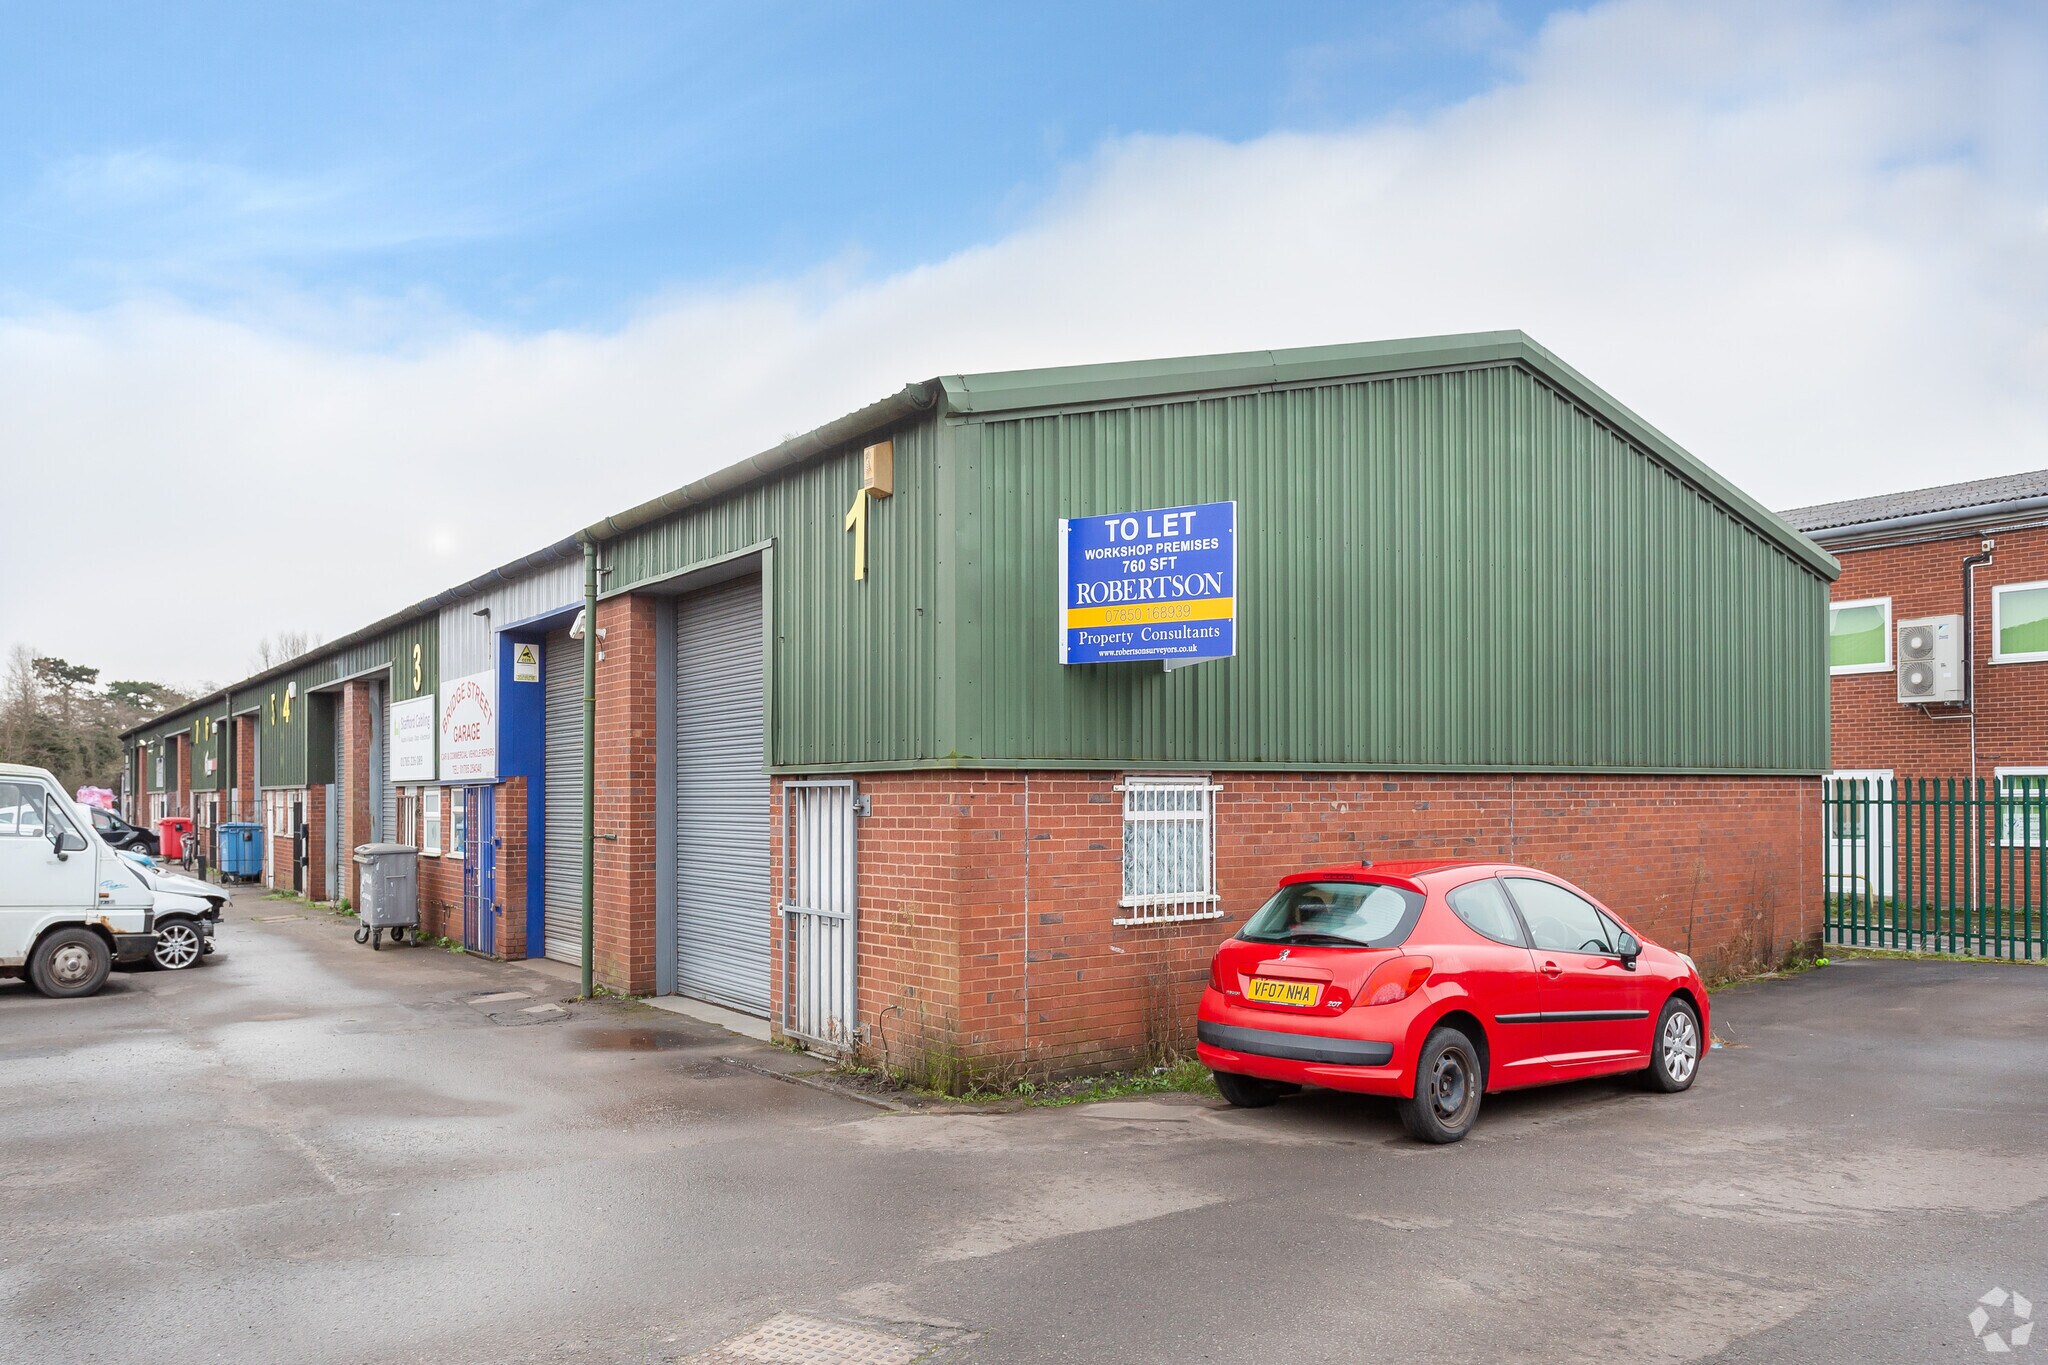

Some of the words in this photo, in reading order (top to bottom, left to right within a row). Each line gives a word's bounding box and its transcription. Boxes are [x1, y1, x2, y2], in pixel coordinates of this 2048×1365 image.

[845, 488, 866, 581] 1
[1104, 518, 1139, 542] TO
[1146, 511, 1197, 539] LET
[1084, 544, 1153, 561] WORKSHOP
[1155, 538, 1220, 554] PREMISES
[1122, 559, 1146, 573] 760
[1149, 556, 1178, 571] SFT
[1076, 571, 1224, 605] ROBERTSON
[1105, 608, 1142, 623] 07850
[1146, 604, 1192, 620] 168939
[1078, 630, 1134, 647] Property
[1141, 625, 1220, 642] Consultants
[1098, 643, 1198, 657] www.robertsonsurveyors.co.uk
[412, 643, 422, 692] 3
[282, 689, 291, 724] 4
[442, 683, 465, 735] BRIDGE
[467, 681, 493, 725] STREET
[453, 722, 481, 743] GARAGE
[1254, 981, 1285, 998] VF07
[1286, 984, 1310, 1002] NHA
[1326, 1000, 1342, 1008] 207
